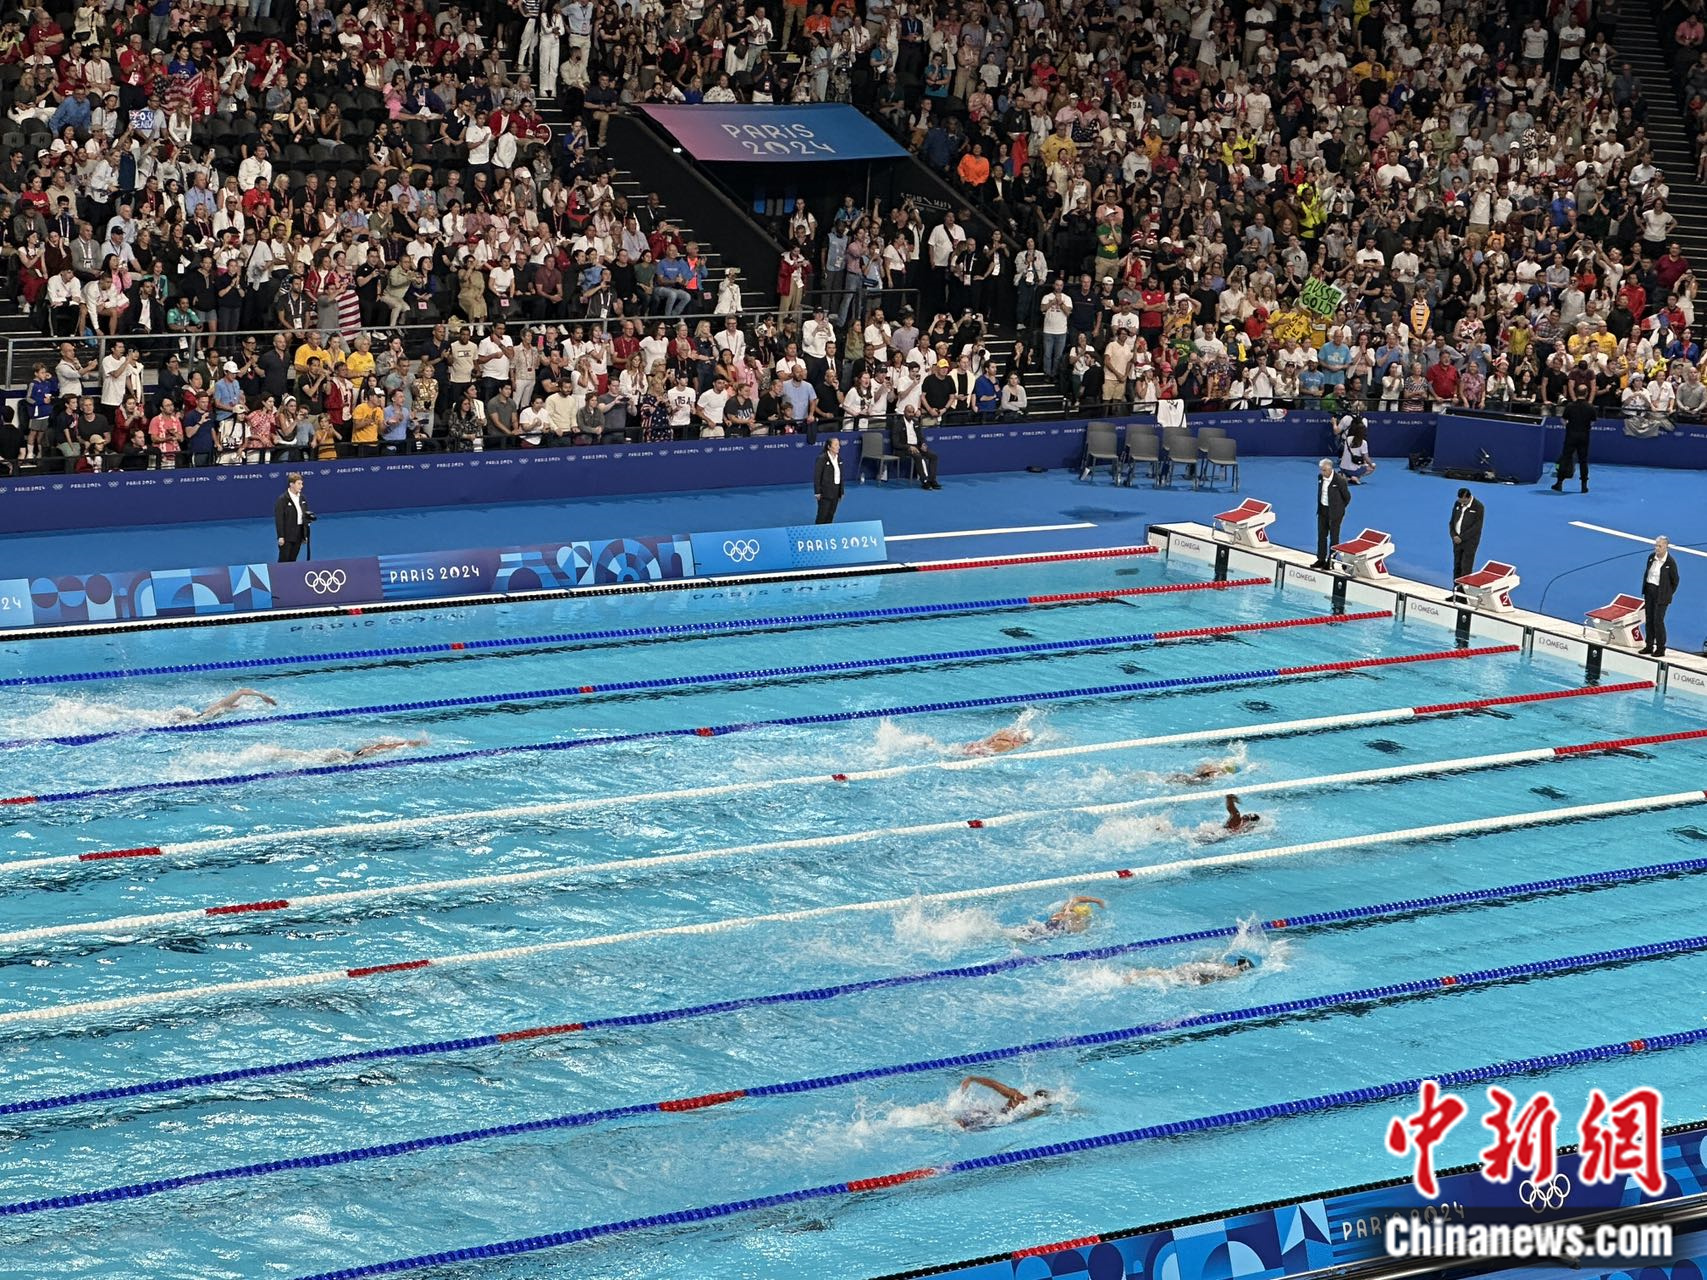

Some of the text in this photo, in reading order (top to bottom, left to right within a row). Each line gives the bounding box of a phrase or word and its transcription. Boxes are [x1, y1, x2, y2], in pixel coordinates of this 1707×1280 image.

[721, 124, 814, 138] PARIS
[742, 140, 837, 155] 2024
[1306, 280, 1342, 305] AUSSIE
[1302, 292, 1333, 315] GOLD
[1258, 530, 1264, 541] 0
[797, 536, 878, 552] PARIS 2024
[1181, 540, 1200, 551] OMEGA
[1378, 562, 1384, 573] 1
[390, 565, 480, 583] PARIS 2024
[1296, 572, 1317, 583] OMEGA
[1, 596, 22, 610] 24
[1502, 595, 1509, 605] 2
[1418, 604, 1439, 616] OMEGA
[1634, 628, 1640, 639] 3
[1546, 640, 1568, 651] OMEGA
[1681, 675, 1705, 687] OMEGA
